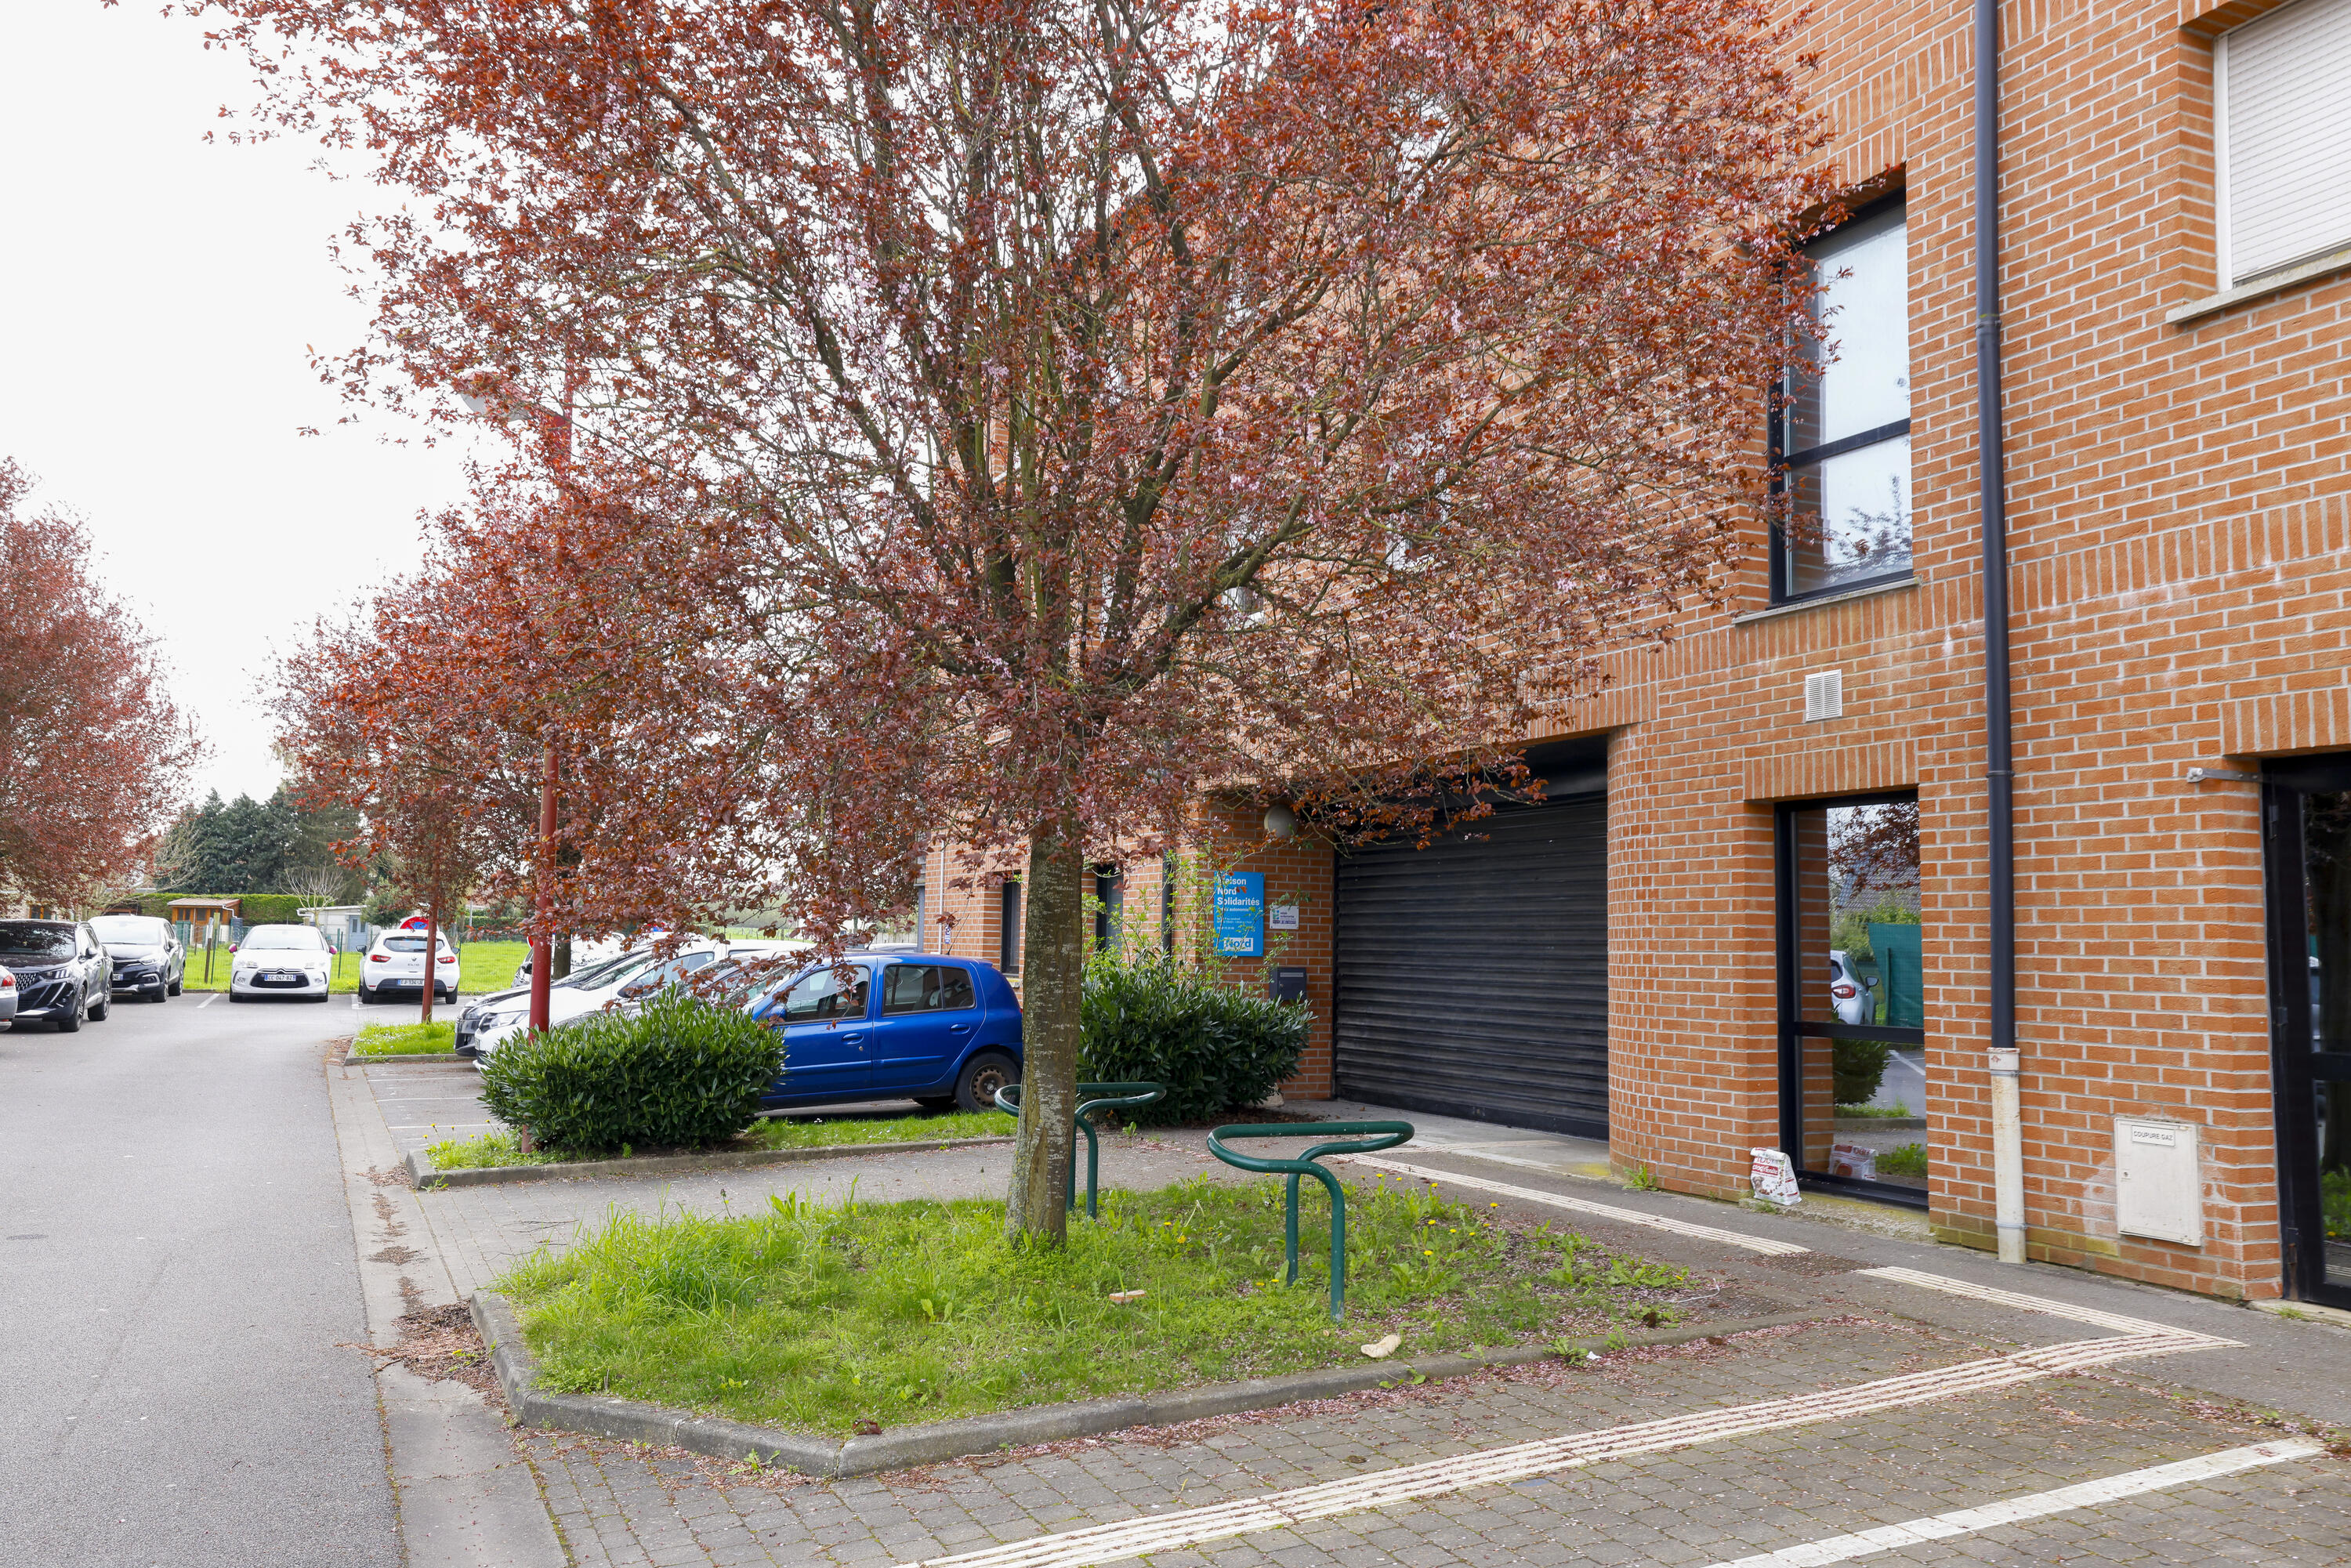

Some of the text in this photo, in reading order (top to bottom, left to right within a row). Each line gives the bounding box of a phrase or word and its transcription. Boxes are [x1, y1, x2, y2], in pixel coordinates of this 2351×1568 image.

[1217, 887, 1237, 896] Nord
[1217, 896, 1260, 906] Solidarités
[1226, 939, 1252, 948] Nord
[2133, 1131, 2161, 1139] COUPURE
